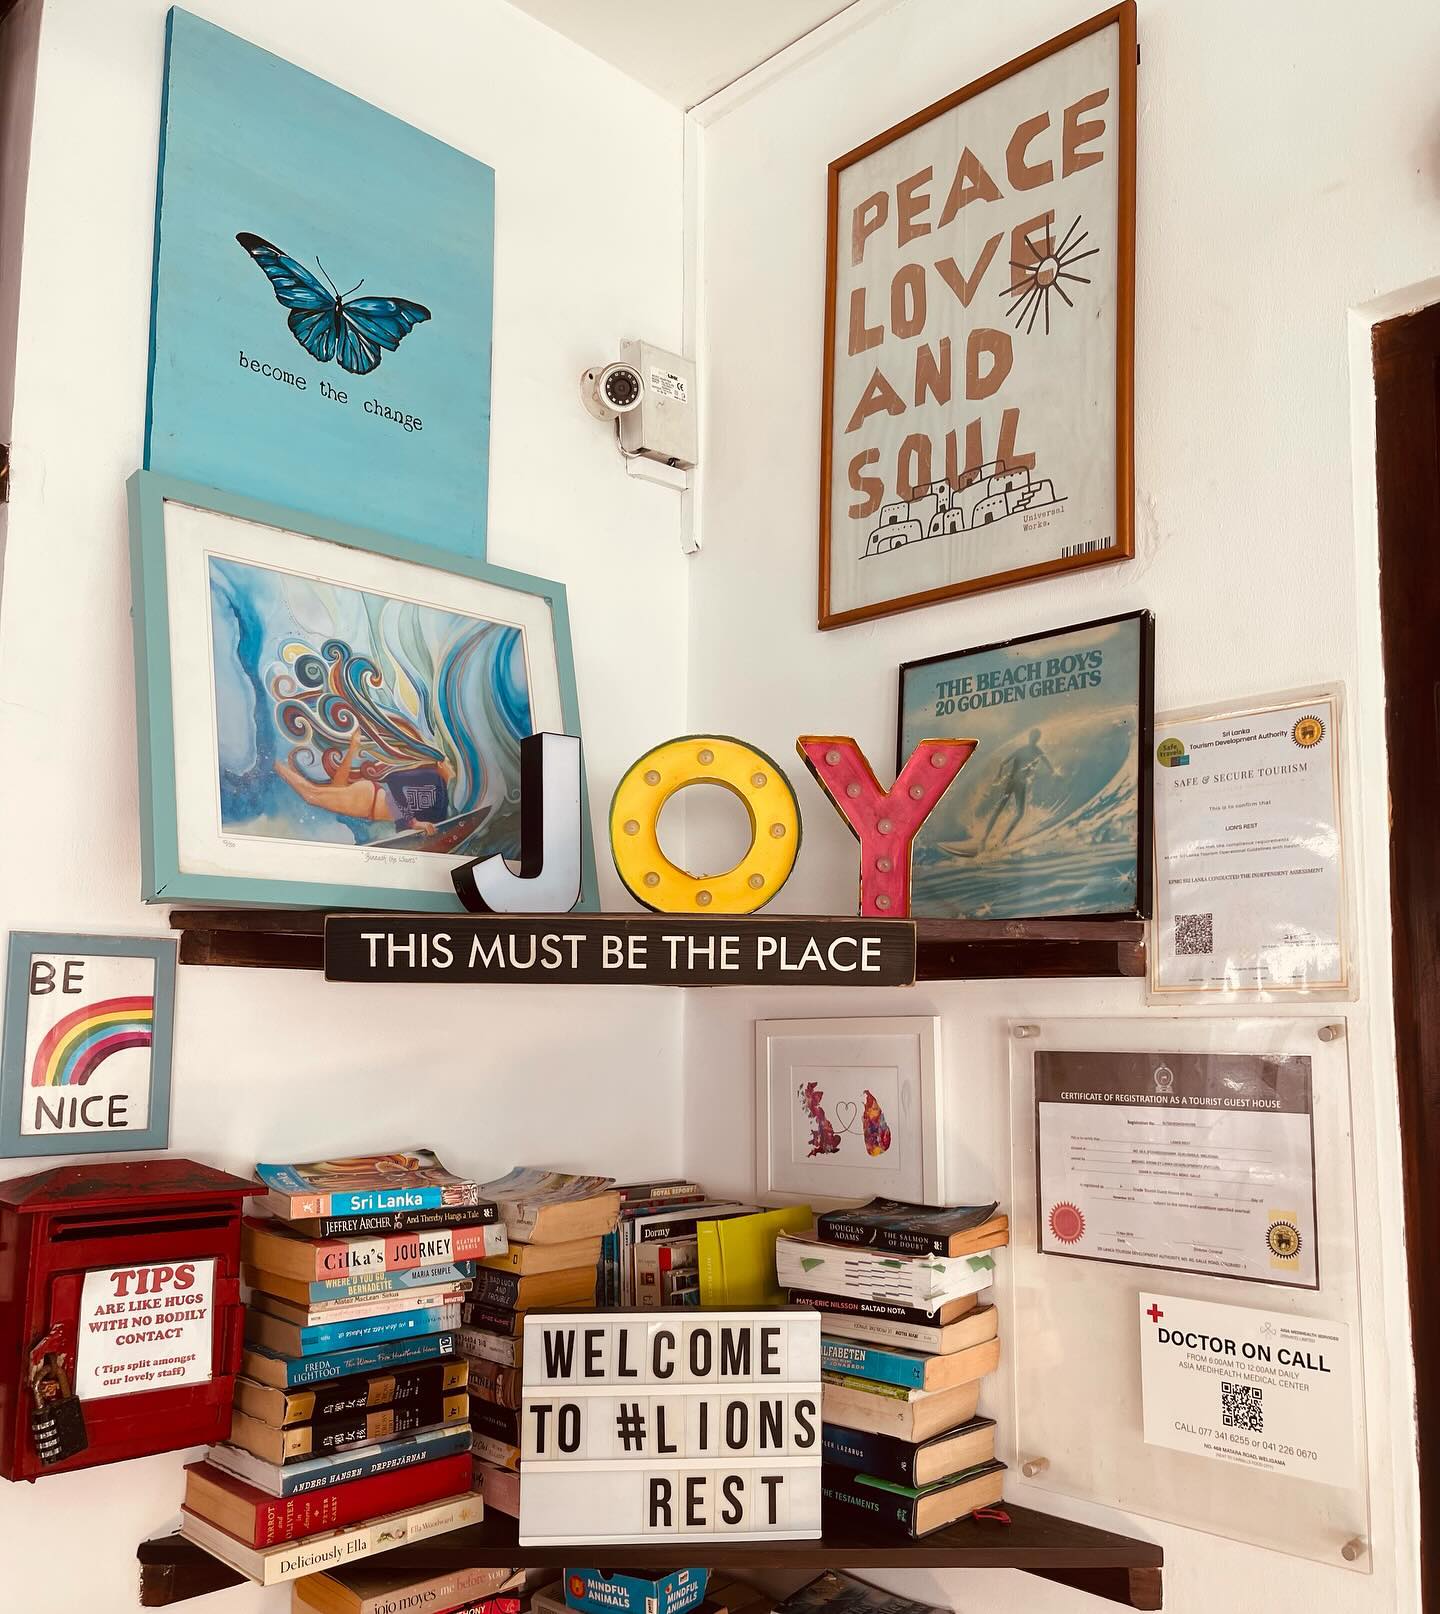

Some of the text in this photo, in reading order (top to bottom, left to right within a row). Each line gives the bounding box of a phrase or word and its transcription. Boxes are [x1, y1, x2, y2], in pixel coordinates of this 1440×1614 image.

[851, 88, 1110, 267] PEACE
[848, 208, 1057, 358] LOVE
[239, 351, 423, 433] become the change
[844, 327, 1014, 434] AND
[848, 407, 1036, 519] SOUL
[1022, 506, 1065, 523] Universal
[1022, 520, 1051, 533] Works.
[936, 650, 1103, 699] THE BEACH BOYS
[935, 670, 1102, 717] 20 GOLDEN GREATS
[1190, 730, 1288, 750] Tourism Development Authority
[1222, 728, 1250, 738] Sri Lanka
[1174, 763, 1308, 788] SAFE & SECURE TOURISM
[451, 731, 979, 918] JOY
[1243, 822, 1258, 830] REST
[361, 932, 881, 972] THIS MUST BE THE PLACE
[30, 960, 85, 995] BE
[35, 1094, 129, 1130] NICE
[1061, 1092, 1281, 1109] CERTIFICATE OF REGISTRATION AS A TOURIST GUEST HOUSE
[351, 1192, 423, 1210] Sri Lanka
[325, 1210, 479, 1236] JEFFREY ARCHER And Thereby Hangs Tale
[644, 1227, 670, 1239] Dormy
[829, 1223, 864, 1235] DOUGLAS
[834, 1231, 860, 1241] ADAMS
[883, 1231, 929, 1243] THE SALMON
[900, 1240, 924, 1250] DOUBT
[324, 1238, 450, 1271] Cilka's JOURNEY
[110, 1264, 196, 1297] TIPS
[325, 1275, 358, 1289] WHERE'D
[411, 1266, 450, 1279] MARIA SEMPLE
[348, 1280, 393, 1296] BERNADETTE
[94, 1293, 204, 1316] ARE LIKE HUGS
[796, 1297, 905, 1315] MATS-ERIC NILSSON SALTAD NOTA
[88, 1308, 207, 1333] WITH NO BODILY
[115, 1327, 183, 1346] CONTACT
[543, 1328, 780, 1379] WELCOME
[1158, 1327, 1331, 1373] DOCTOR ON CALL
[102, 1353, 196, 1374] Tips split amongst
[293, 1367, 341, 1383] LIGHTFOOT
[305, 1361, 330, 1372] FREDA
[1186, 1353, 1207, 1363] FROM
[1235, 1361, 1246, 1370] TO
[1278, 1369, 1300, 1380] DAILY
[103, 1366, 186, 1386] our lovely staff)
[1178, 1361, 1310, 1392] ASIA MEDIHEALTH MEDICAL CENTER
[530, 1399, 816, 1453] TO #LIONS
[837, 1441, 864, 1457] LAZARUS
[1174, 1421, 1318, 1461] CALL 077 341 6255 or 041 226 0670
[1223, 1447, 1242, 1456] MATARA
[1259, 1455, 1286, 1466] WELIGAMA
[292, 1477, 327, 1493] ANDERS
[330, 1467, 363, 1484] HANSEN
[650, 1475, 784, 1527] REST
[835, 1492, 880, 1512] TESTAMENTS
[267, 1506, 275, 1543] PARROT
[280, 1544, 343, 1573] Deliciously
[346, 1538, 368, 1554] Ella
[400, 1590, 437, 1610] moyes
[456, 1575, 485, 1591] before
[587, 1579, 629, 1597] MINDFUL
[588, 1591, 630, 1608] ANIMALS
[667, 1580, 698, 1604] MINDFUL
[666, 1591, 698, 1614] ANIMALS
